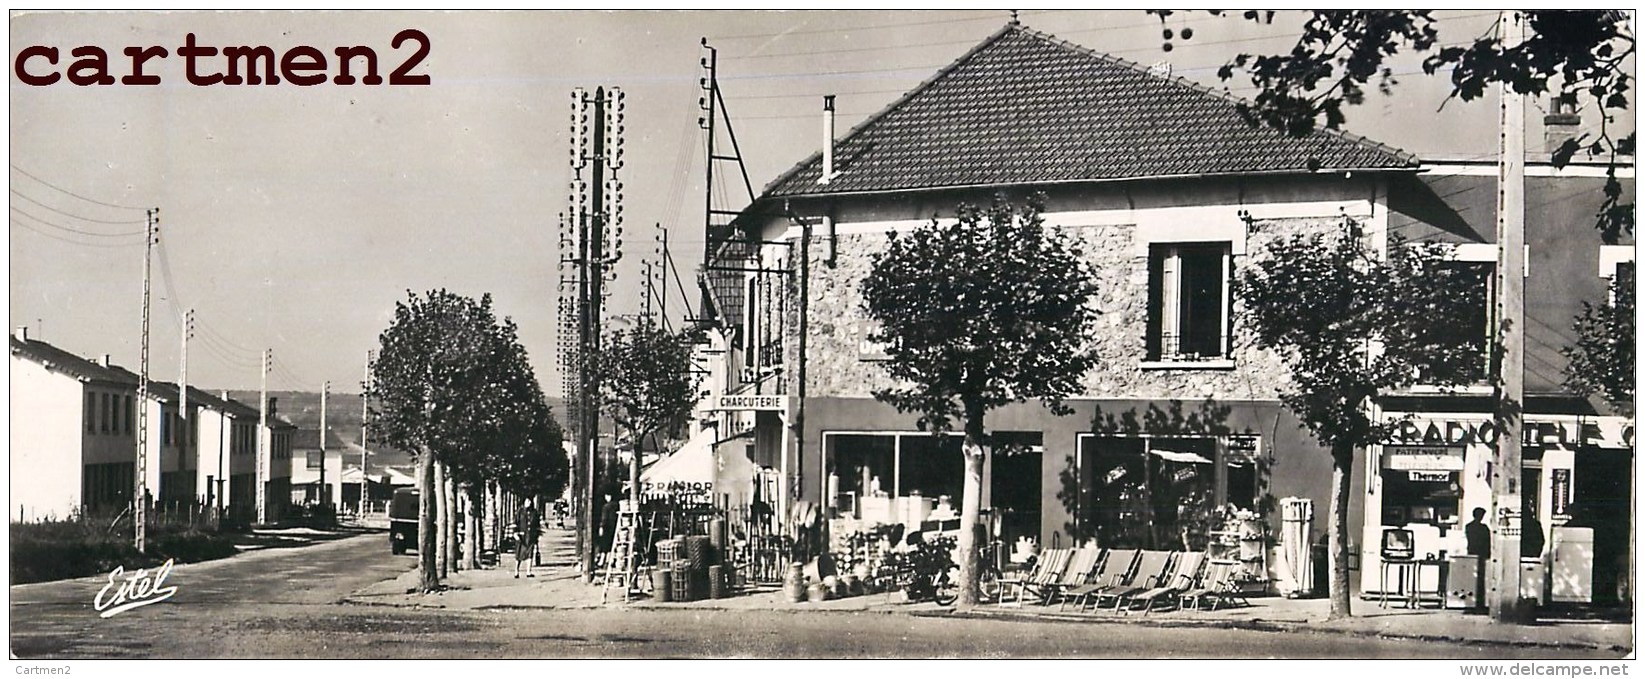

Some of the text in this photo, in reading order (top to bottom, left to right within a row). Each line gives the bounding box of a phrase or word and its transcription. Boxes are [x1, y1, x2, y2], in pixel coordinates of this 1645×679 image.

[720, 396, 781, 408] CHARCUTERIE
[1400, 419, 1496, 447] RADIO
[1412, 471, 1448, 481] Thermor
